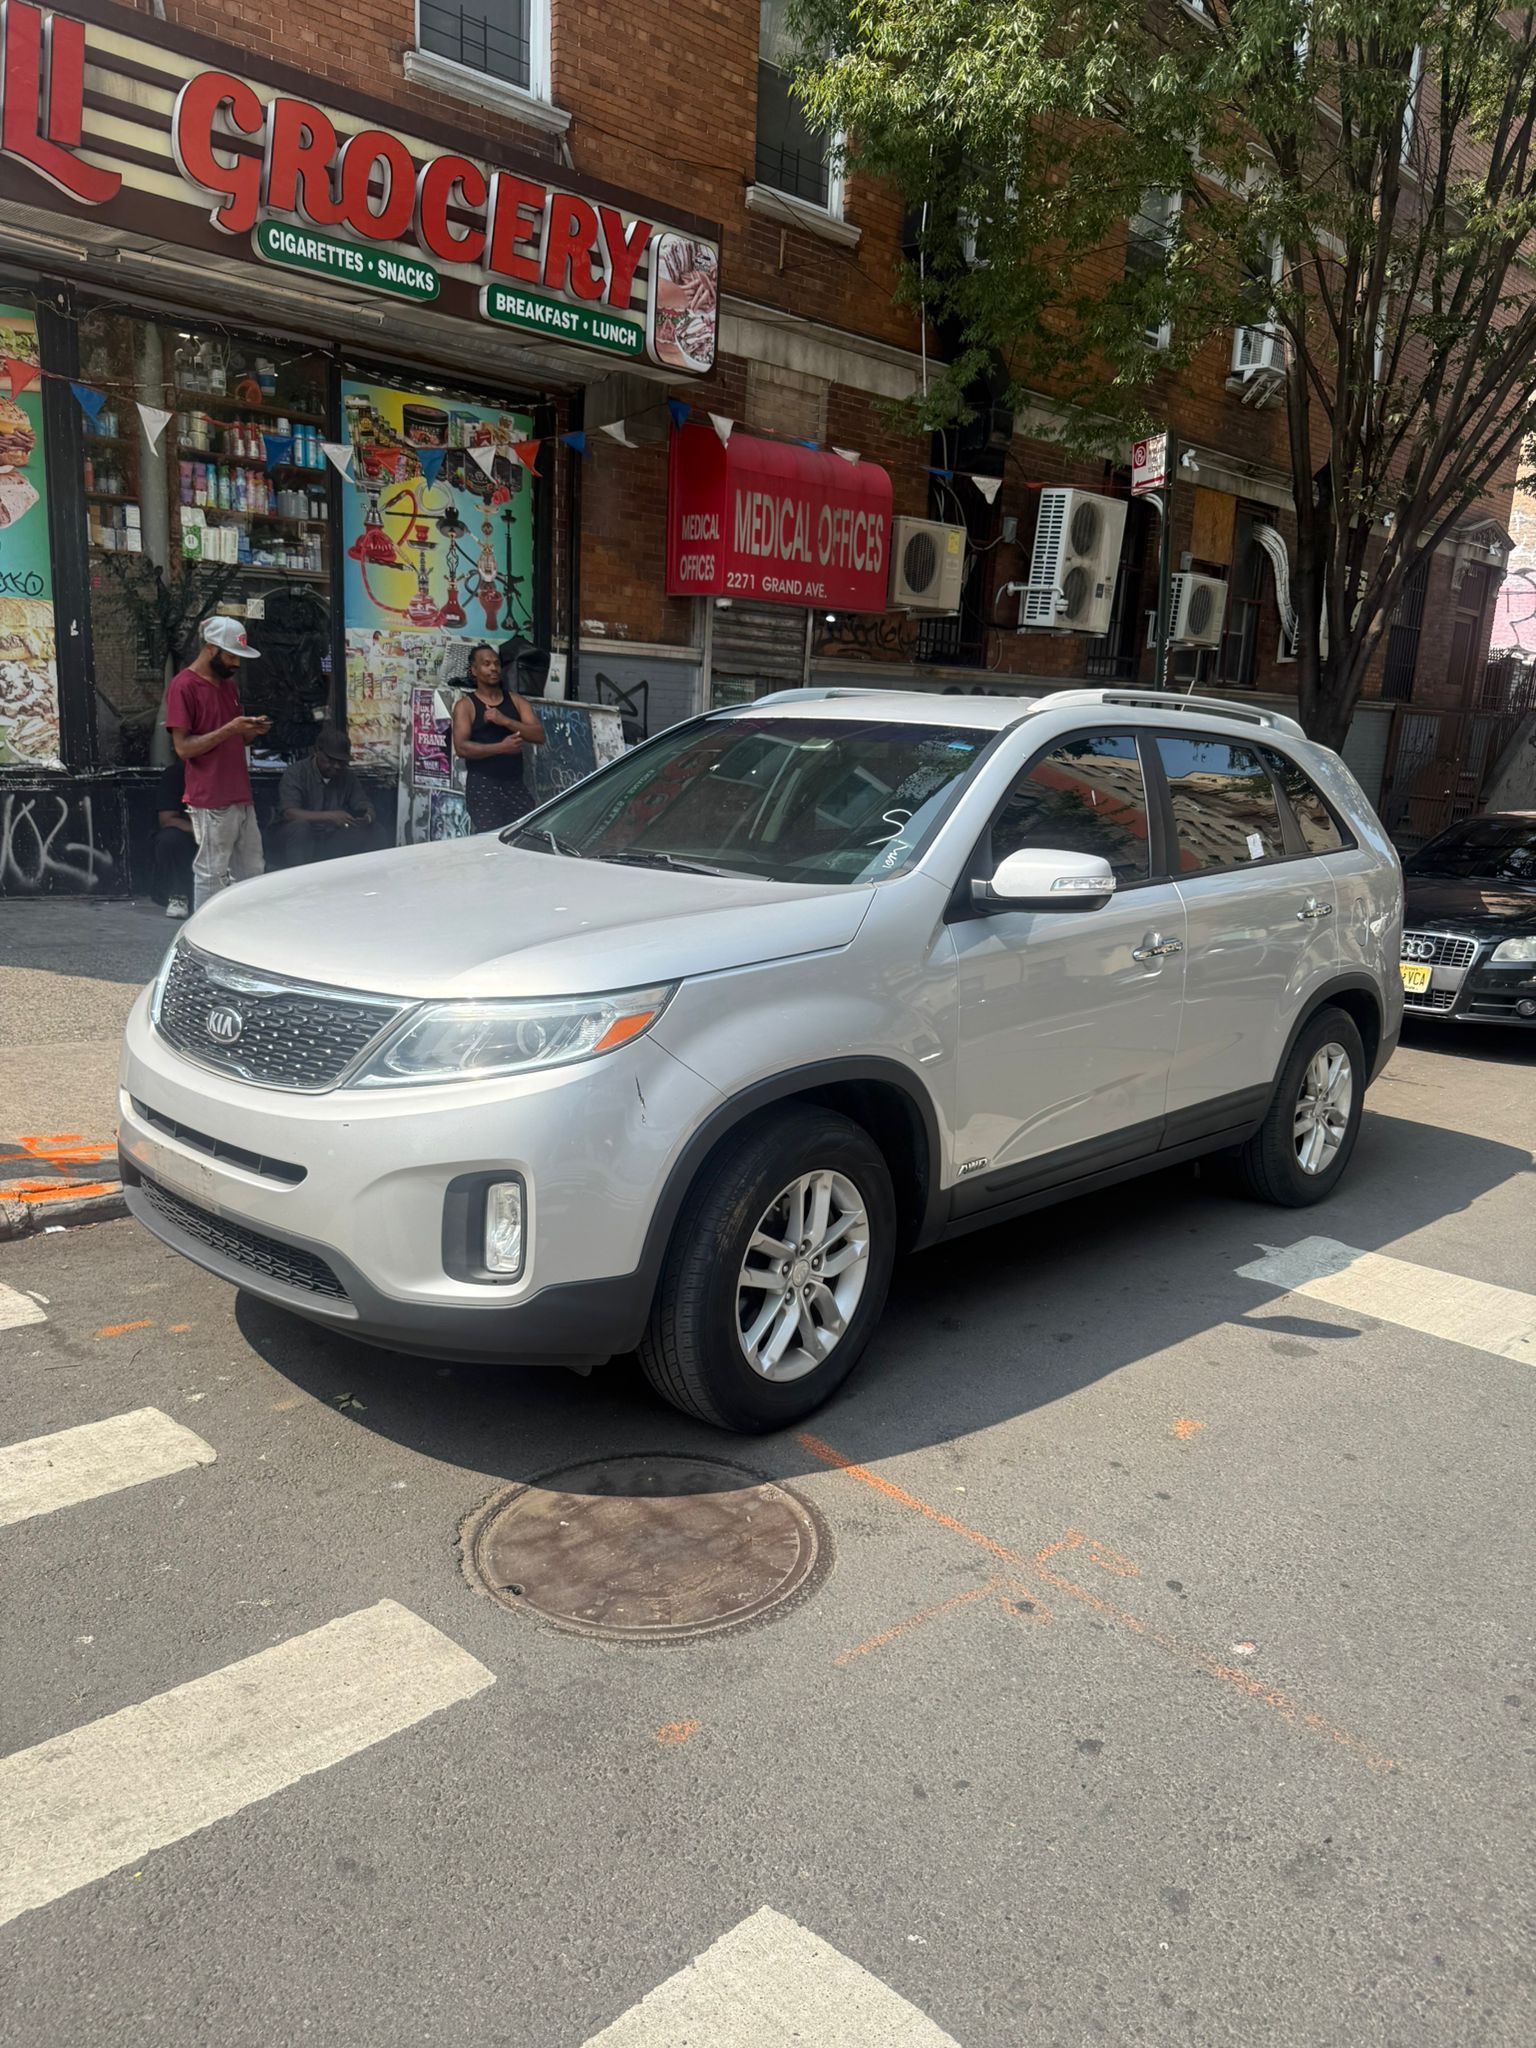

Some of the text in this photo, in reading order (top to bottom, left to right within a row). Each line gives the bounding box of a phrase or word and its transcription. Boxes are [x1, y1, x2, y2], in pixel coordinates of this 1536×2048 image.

[172, 70, 654, 310] GROCERY
[268, 228, 436, 293] CIGARETTES SNACKS
[495, 292, 637, 348] BREAKFAST LUNCH
[681, 513, 720, 541] MEDICAL
[733, 488, 885, 574] MEDICAL OFFICES
[679, 554, 716, 581] OFFICES
[726, 571, 828, 599] 2271 GRAND AVE.
[420, 712, 432, 726] 12
[417, 732, 447, 748] FRANK
[209, 1010, 233, 1037] KIA
